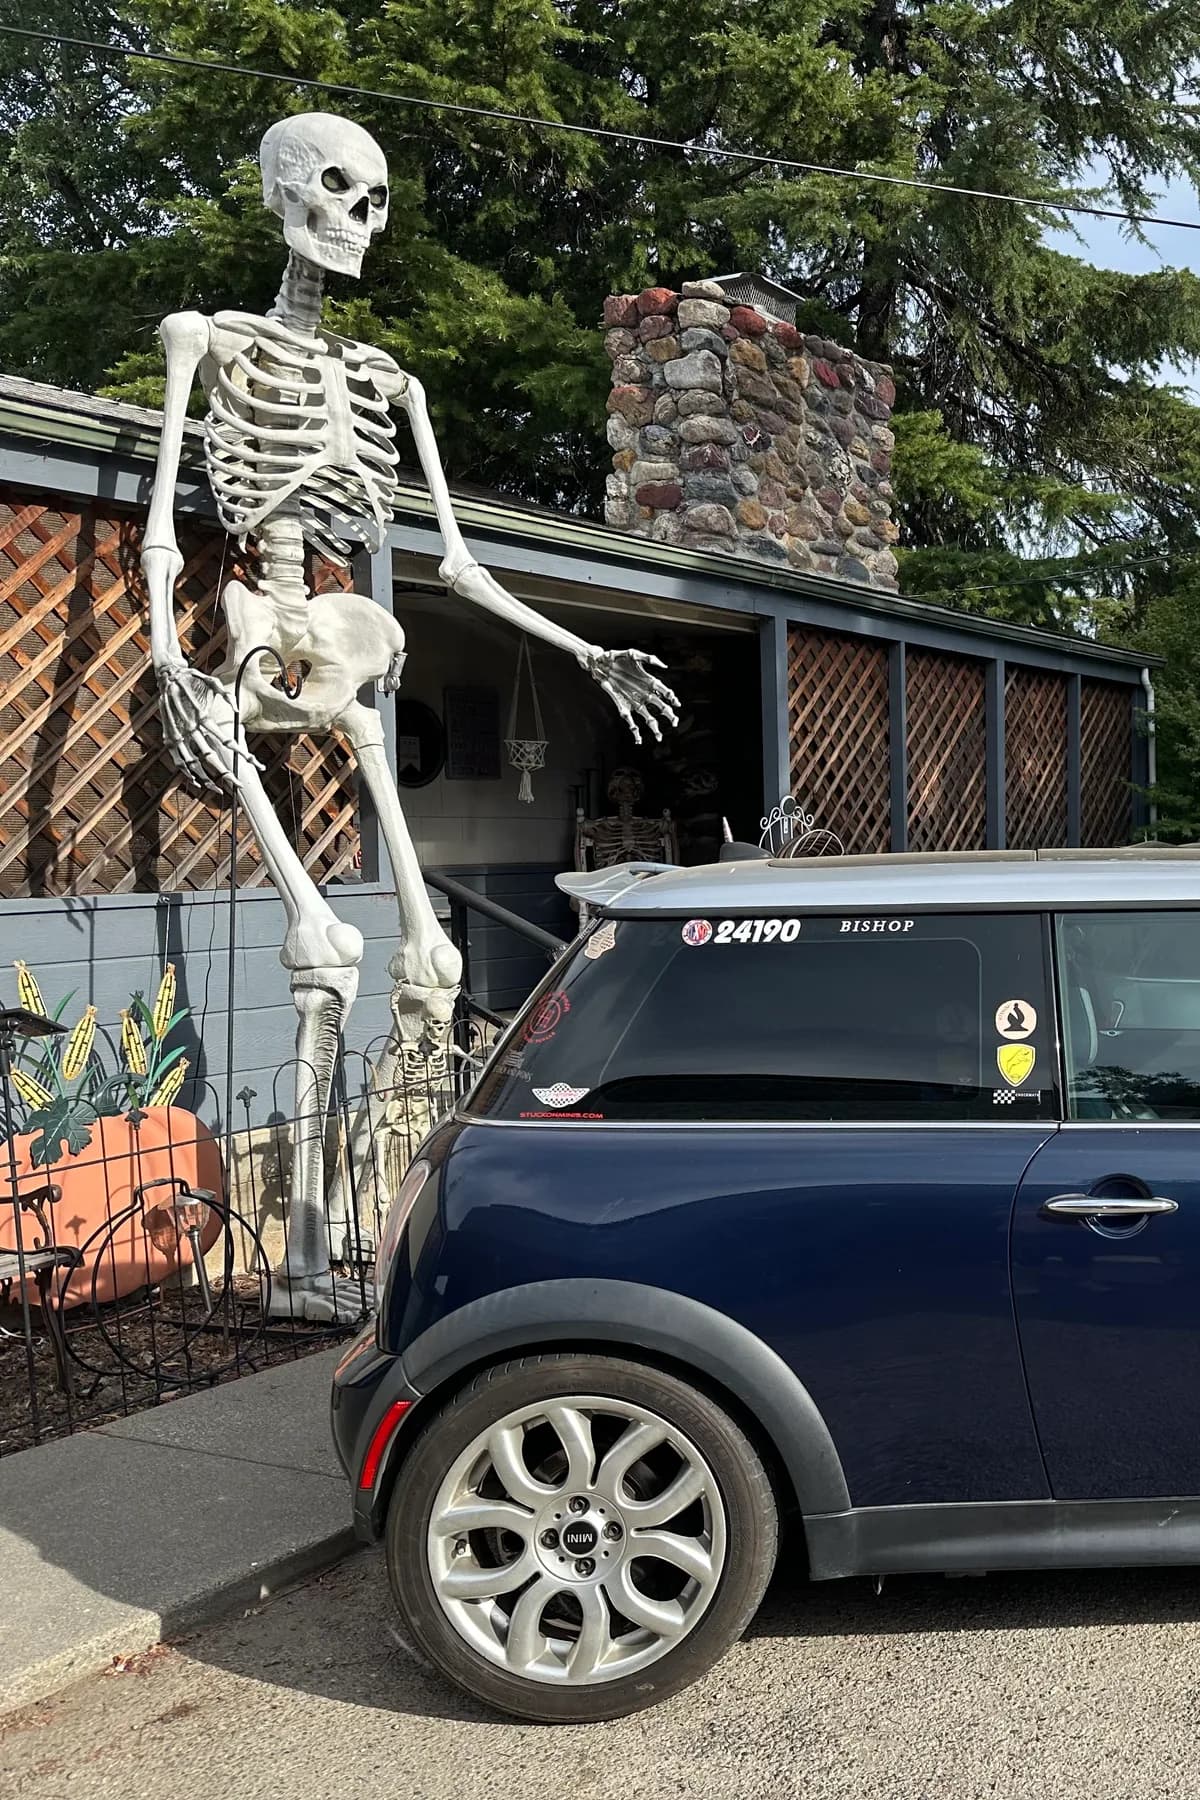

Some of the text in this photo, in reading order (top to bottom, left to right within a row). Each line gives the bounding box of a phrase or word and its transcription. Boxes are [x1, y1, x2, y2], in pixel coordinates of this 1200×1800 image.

[713, 918, 801, 944] 24190
[839, 920, 914, 933] BISHOP
[567, 1533, 593, 1543] MINI
